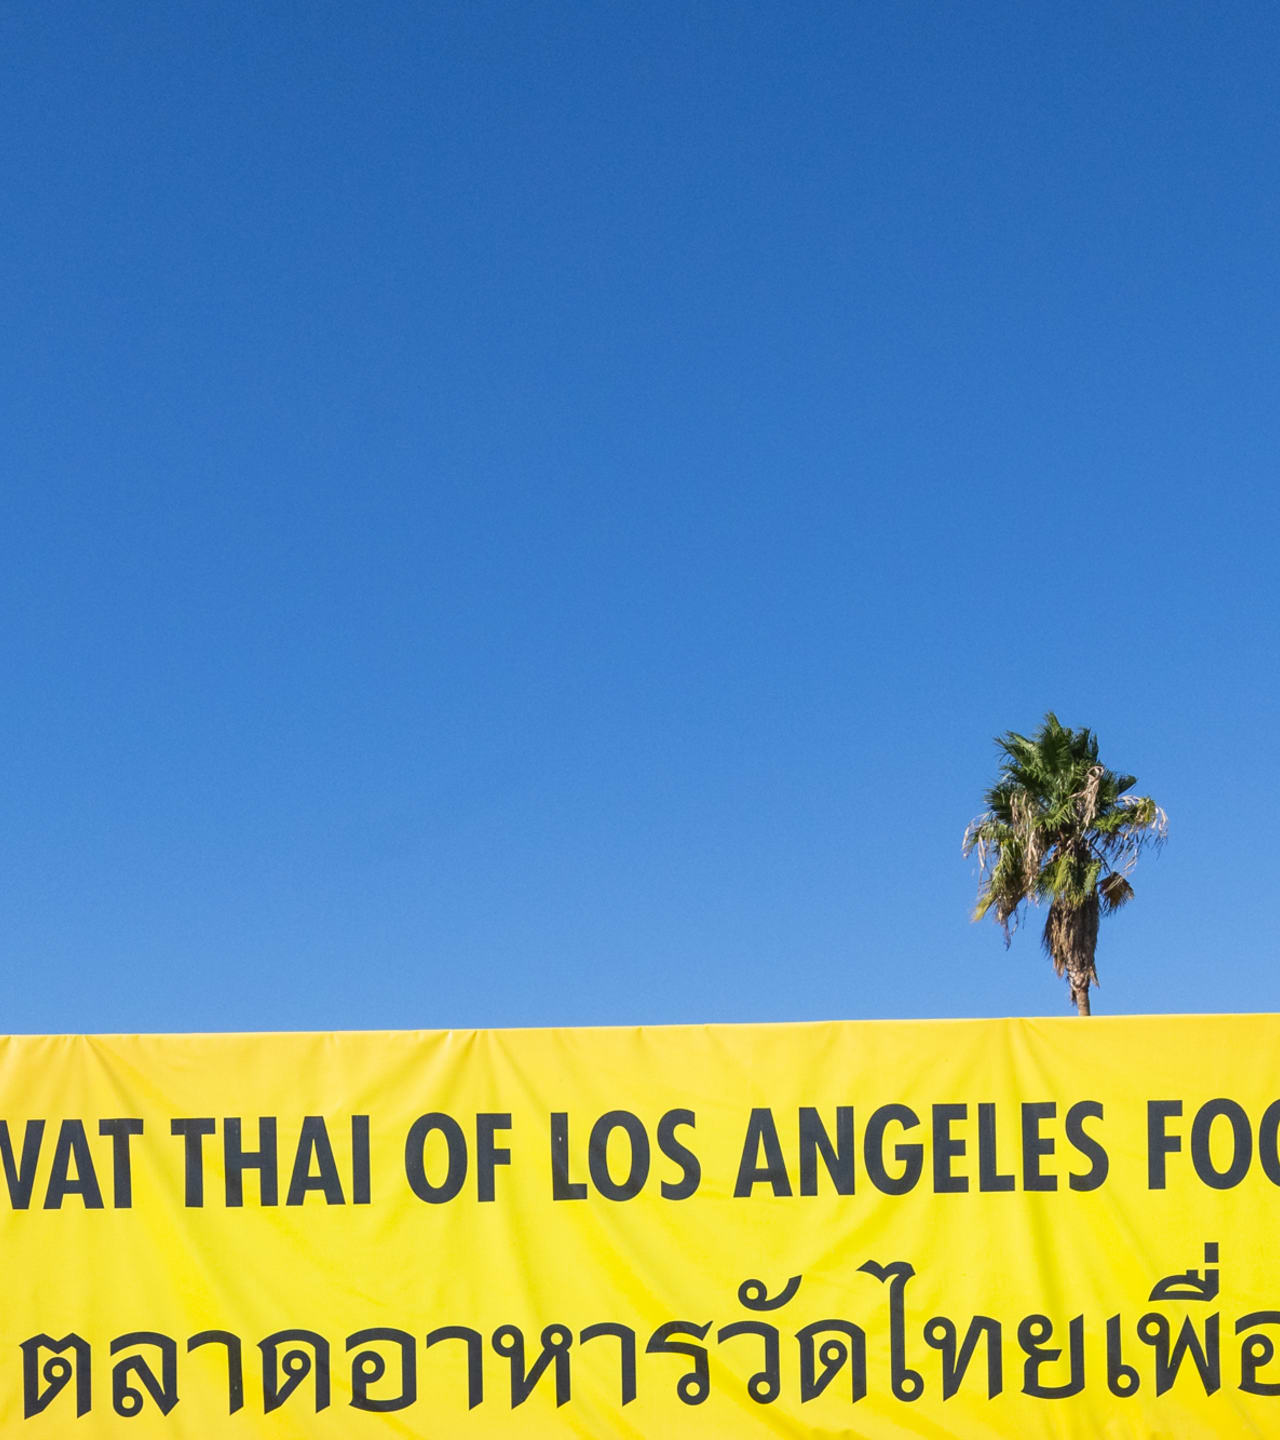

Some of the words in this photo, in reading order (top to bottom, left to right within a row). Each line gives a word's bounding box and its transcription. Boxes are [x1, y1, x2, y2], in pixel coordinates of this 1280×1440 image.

[170, 1114, 371, 1209] THAI
[404, 1111, 512, 1203] OF
[550, 1108, 702, 1202] LOS
[733, 1100, 1110, 1199] ANGELES
